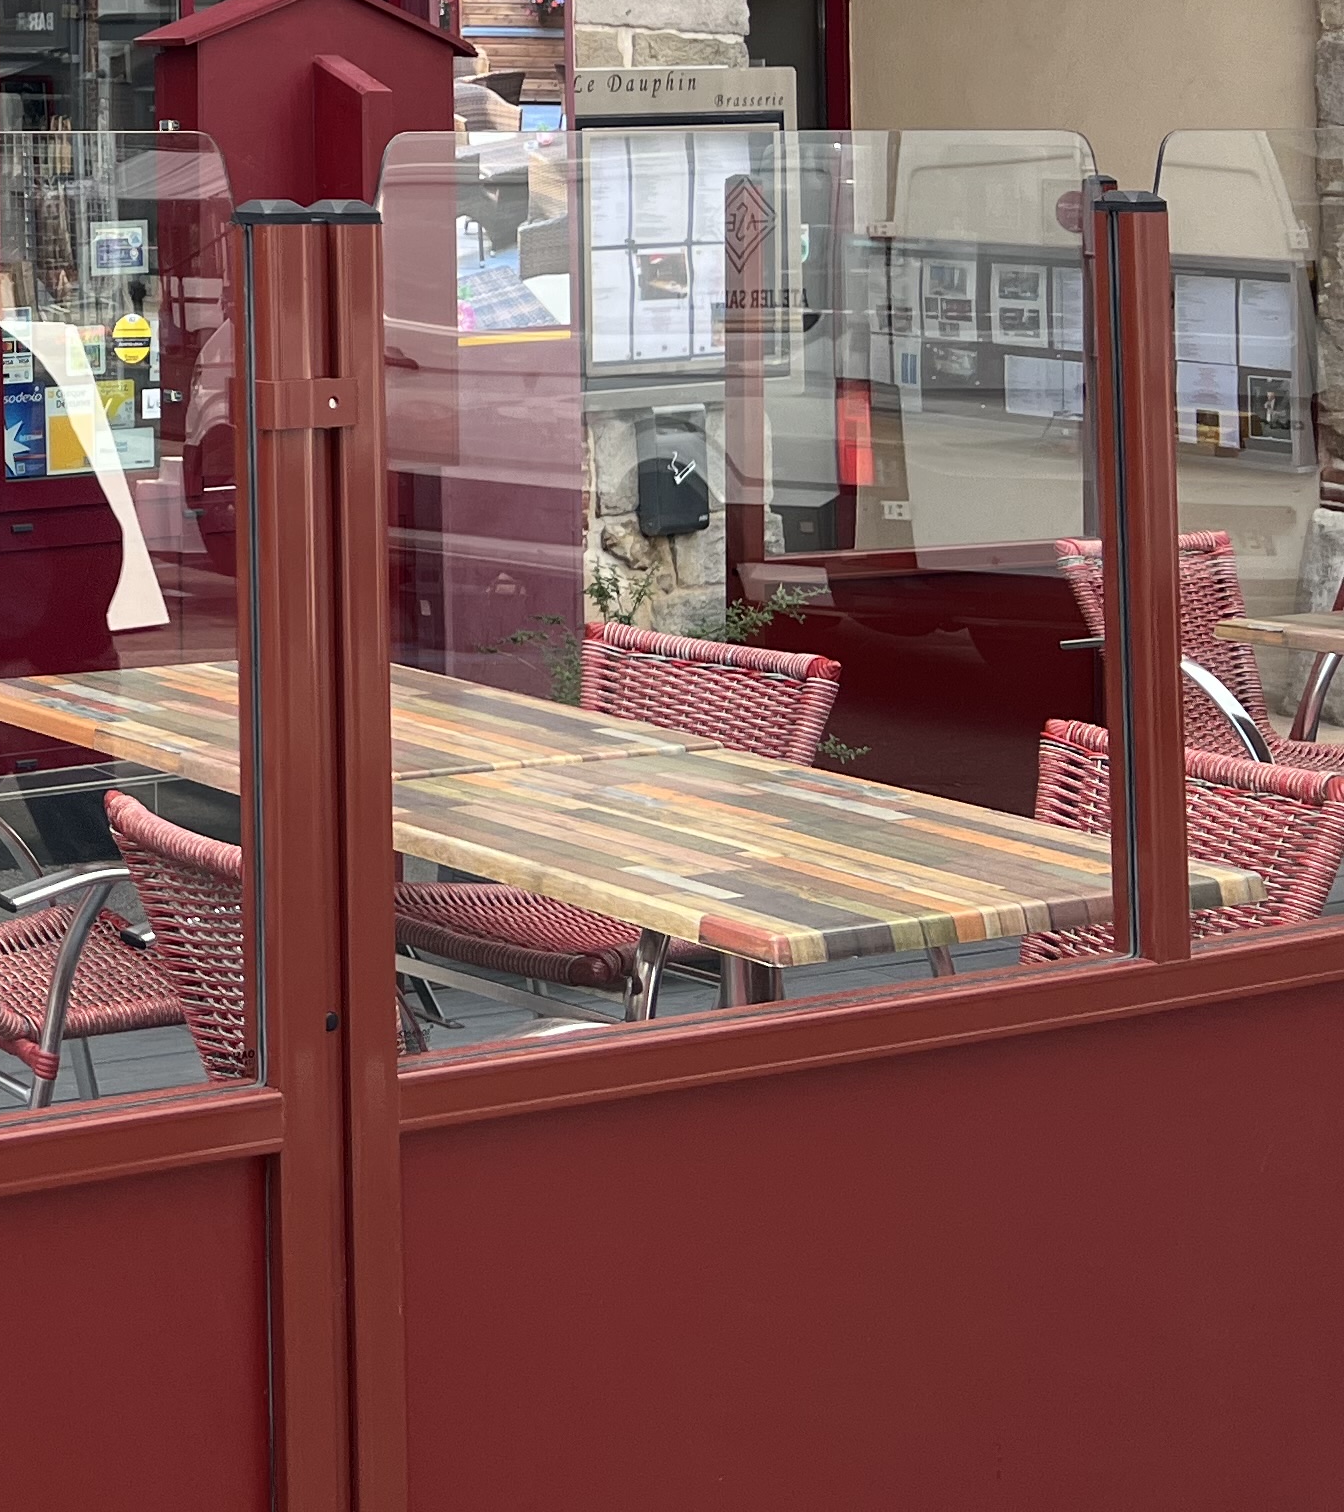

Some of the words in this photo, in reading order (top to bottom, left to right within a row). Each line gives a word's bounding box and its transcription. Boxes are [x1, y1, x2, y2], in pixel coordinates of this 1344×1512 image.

[573, 74, 595, 94] Le
[606, 70, 698, 98] Dauphin
[713, 92, 785, 108] Brasserie
